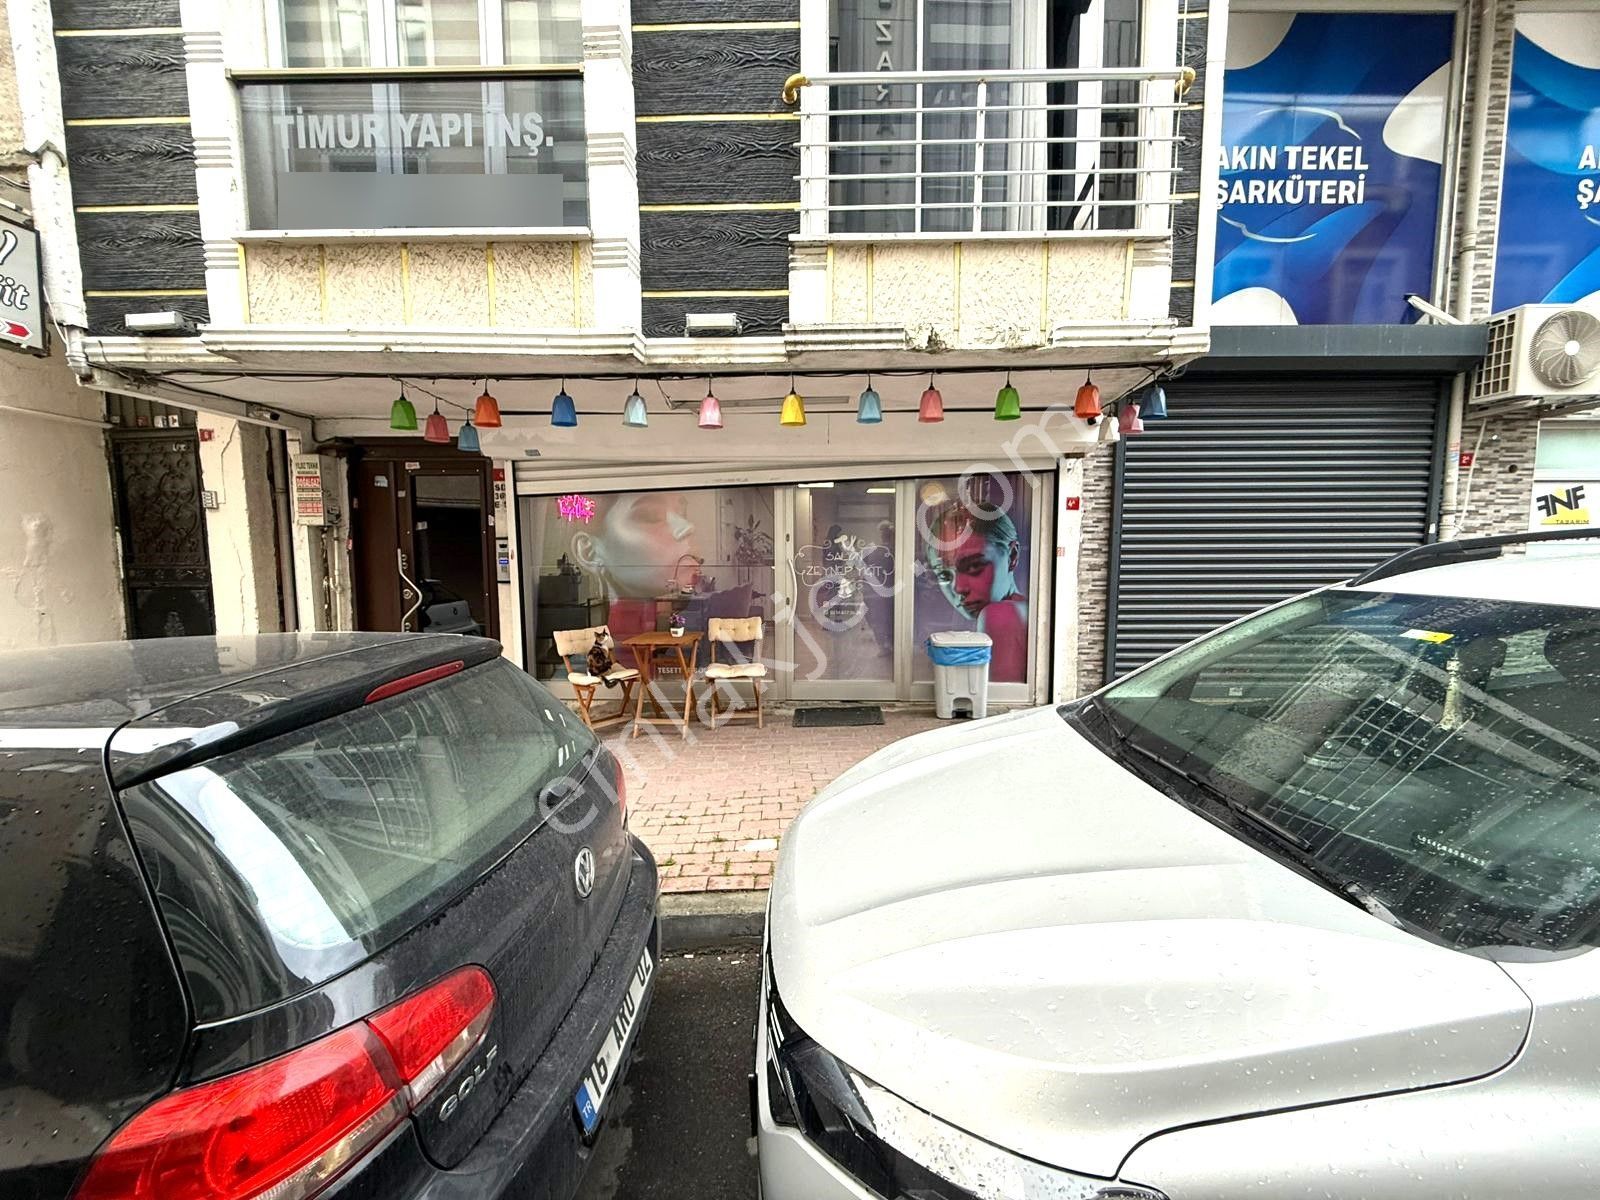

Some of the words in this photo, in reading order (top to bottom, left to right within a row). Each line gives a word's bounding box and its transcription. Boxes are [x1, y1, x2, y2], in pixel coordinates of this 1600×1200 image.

[272, 105, 387, 150] TİMUR
[398, 112, 473, 148] YAPI
[486, 104, 555, 157] İNŞ.
[1218, 145, 1277, 171] AKIN
[1284, 145, 1369, 171] TEKEL
[1578, 144, 1600, 170] A
[1216, 173, 1366, 210] ŞARKÜTERİ
[438, 1044, 498, 1121] GOLF
